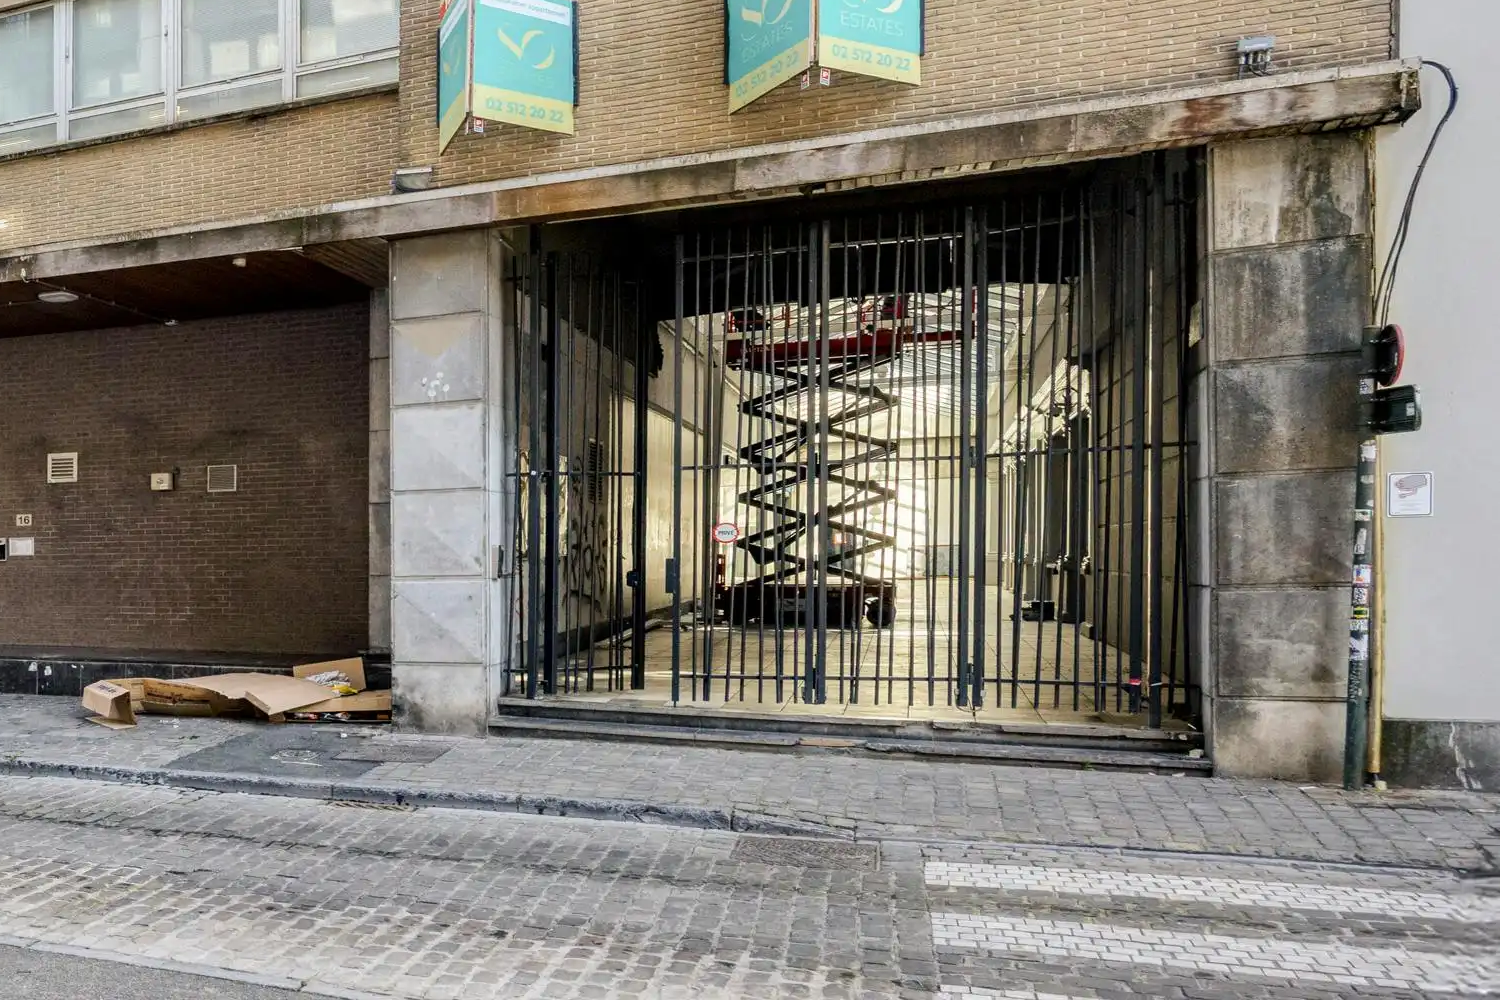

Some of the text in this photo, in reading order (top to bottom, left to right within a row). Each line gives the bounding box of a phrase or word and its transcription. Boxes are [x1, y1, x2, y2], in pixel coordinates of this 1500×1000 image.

[840, 10, 904, 37] ESTATES
[831, 43, 912, 72] 02 512 20 22
[485, 97, 565, 123] 02 512 20 22
[18, 515, 31, 525] 16
